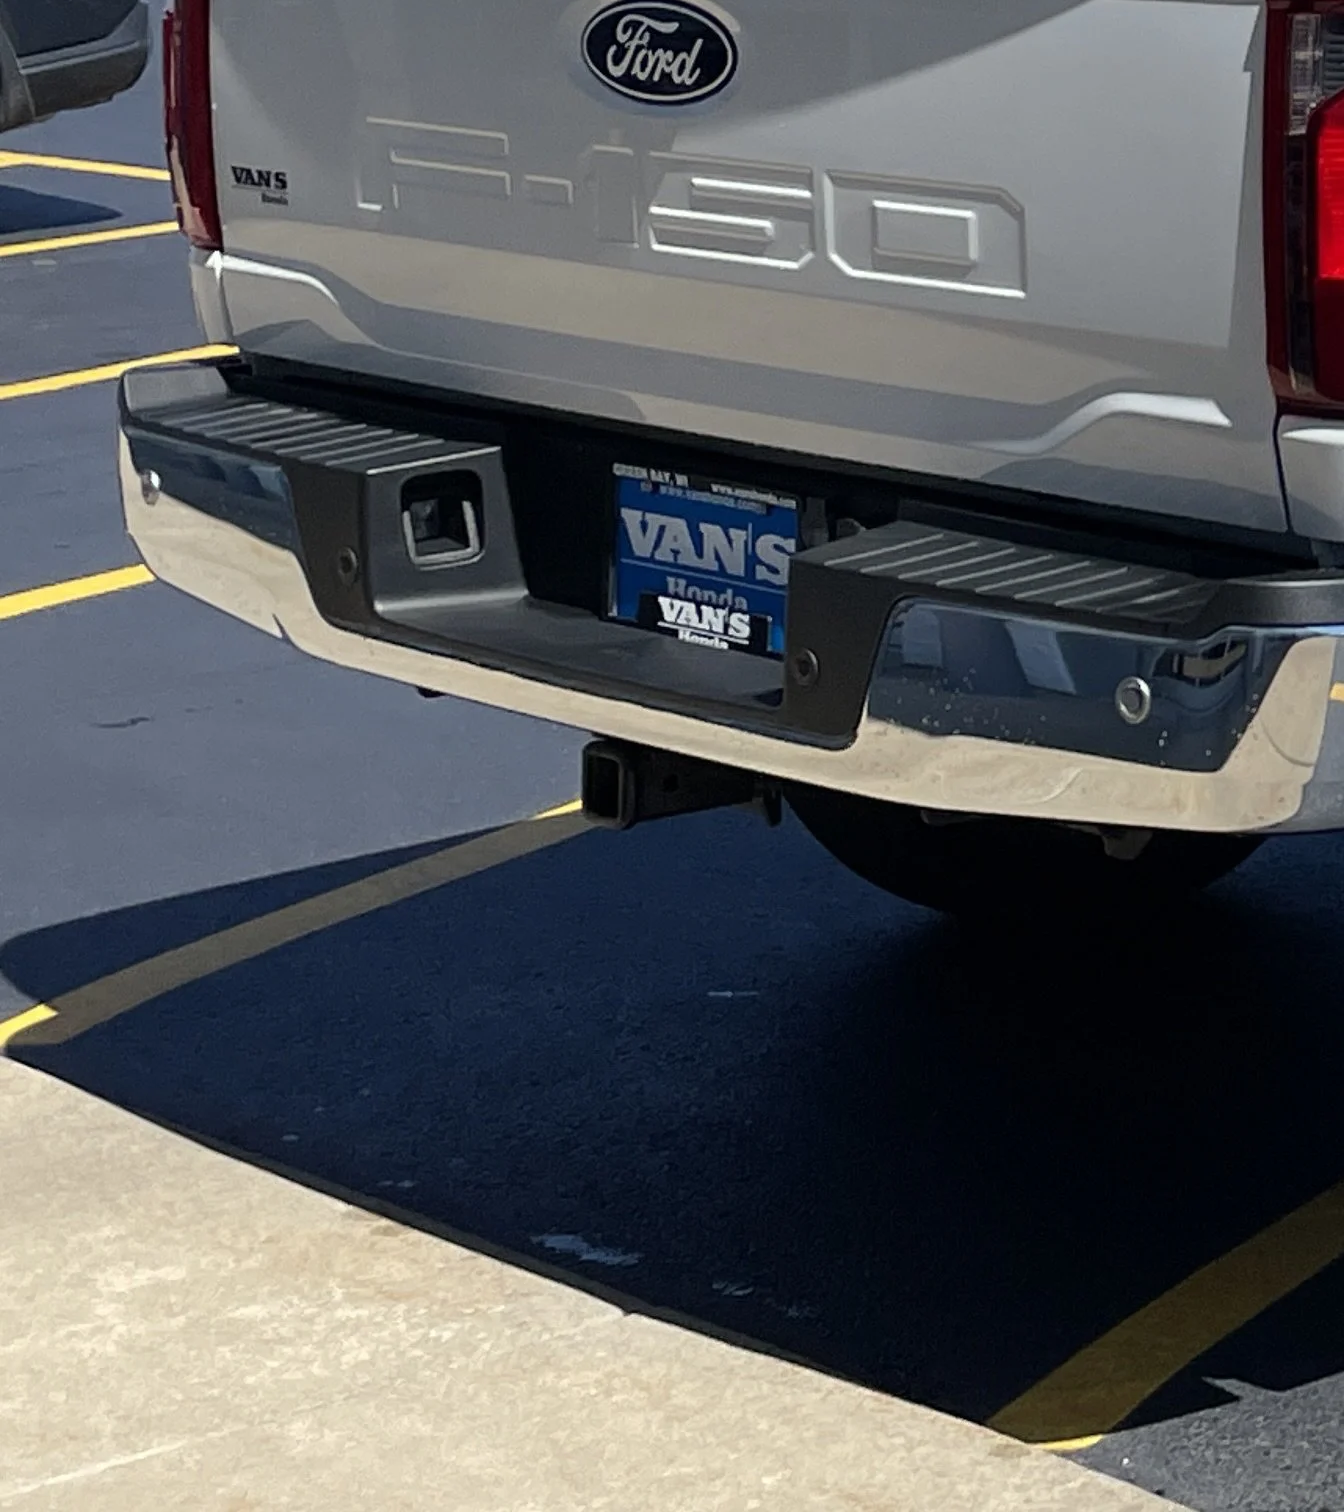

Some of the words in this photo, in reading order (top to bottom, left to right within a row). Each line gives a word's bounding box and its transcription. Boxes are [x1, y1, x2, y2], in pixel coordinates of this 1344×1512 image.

[607, 14, 703, 86] Ford
[357, 117, 1026, 298] F-150
[620, 507, 796, 585] VAN'S
[658, 595, 750, 638] VAN'S
[666, 576, 747, 610] Honda
[678, 629, 728, 650] Honda
